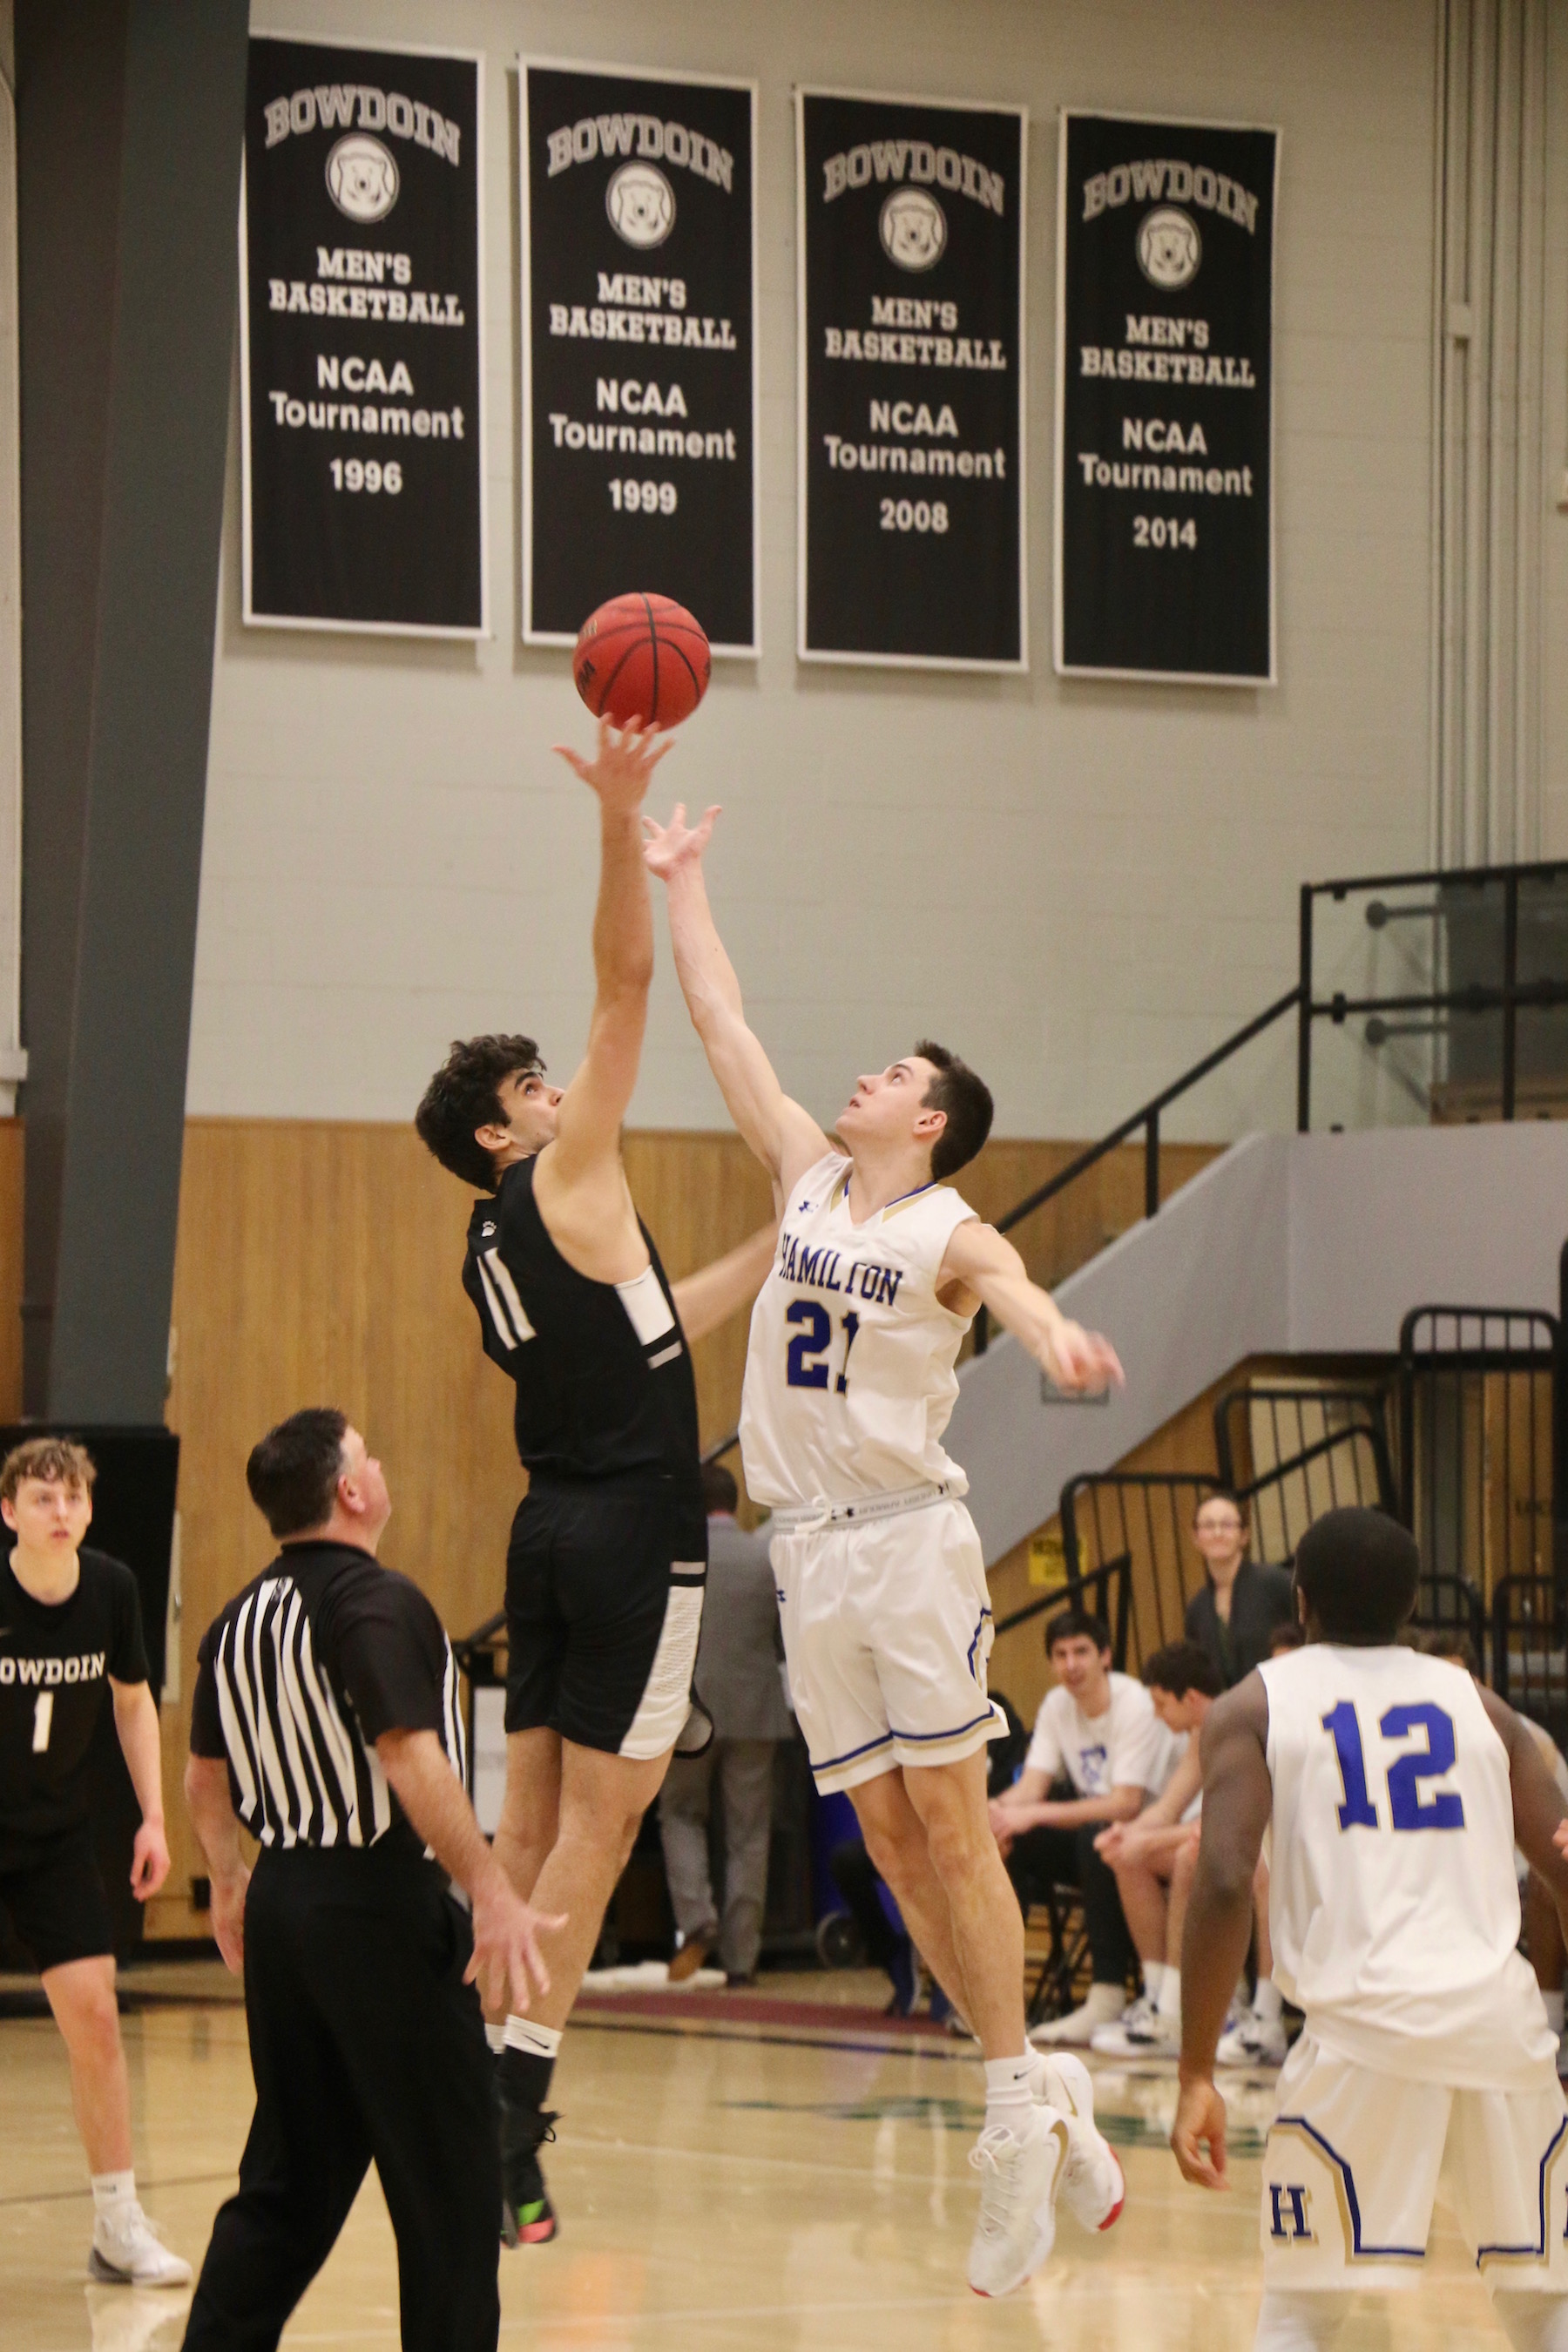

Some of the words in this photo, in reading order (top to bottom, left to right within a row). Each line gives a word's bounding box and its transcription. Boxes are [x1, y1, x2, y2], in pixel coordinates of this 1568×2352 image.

[264, 84, 461, 167] BOWDOIN
[546, 113, 733, 193] BOWDOIN
[822, 139, 1004, 217] BOWDOIN
[1082, 159, 1258, 235] BOWDOIN
[316, 247, 412, 285] MEN'S
[268, 279, 465, 327] BASKETBALL
[597, 272, 687, 310] MEN'S
[549, 303, 738, 350] BASKETBALL
[871, 295, 958, 331] MEN'S
[1125, 314, 1209, 348] MEN'S
[824, 328, 1007, 370] BASKETBALL
[1080, 347, 1256, 389] BASKETBALL
[316, 355, 415, 396] NCAA
[268, 390, 465, 439] Tournament
[596, 377, 688, 418] NCAA
[868, 400, 959, 437] NCAA
[548, 412, 737, 461] Tournament
[823, 435, 1006, 478] Tournament
[1122, 418, 1208, 455] NCAA
[329, 458, 403, 495] 1996
[1078, 453, 1253, 496] Tournament
[608, 478, 678, 515] 1999
[879, 498, 950, 533] 2008
[1132, 516, 1198, 549] 2014
[779, 1233, 903, 1308] HAMILTON
[476, 1247, 537, 1351] 11
[786, 1298, 861, 1397] 21
[32, 1691, 54, 1754] 1
[1321, 1700, 1466, 1833] 12
[1269, 2182, 1318, 2245] H
